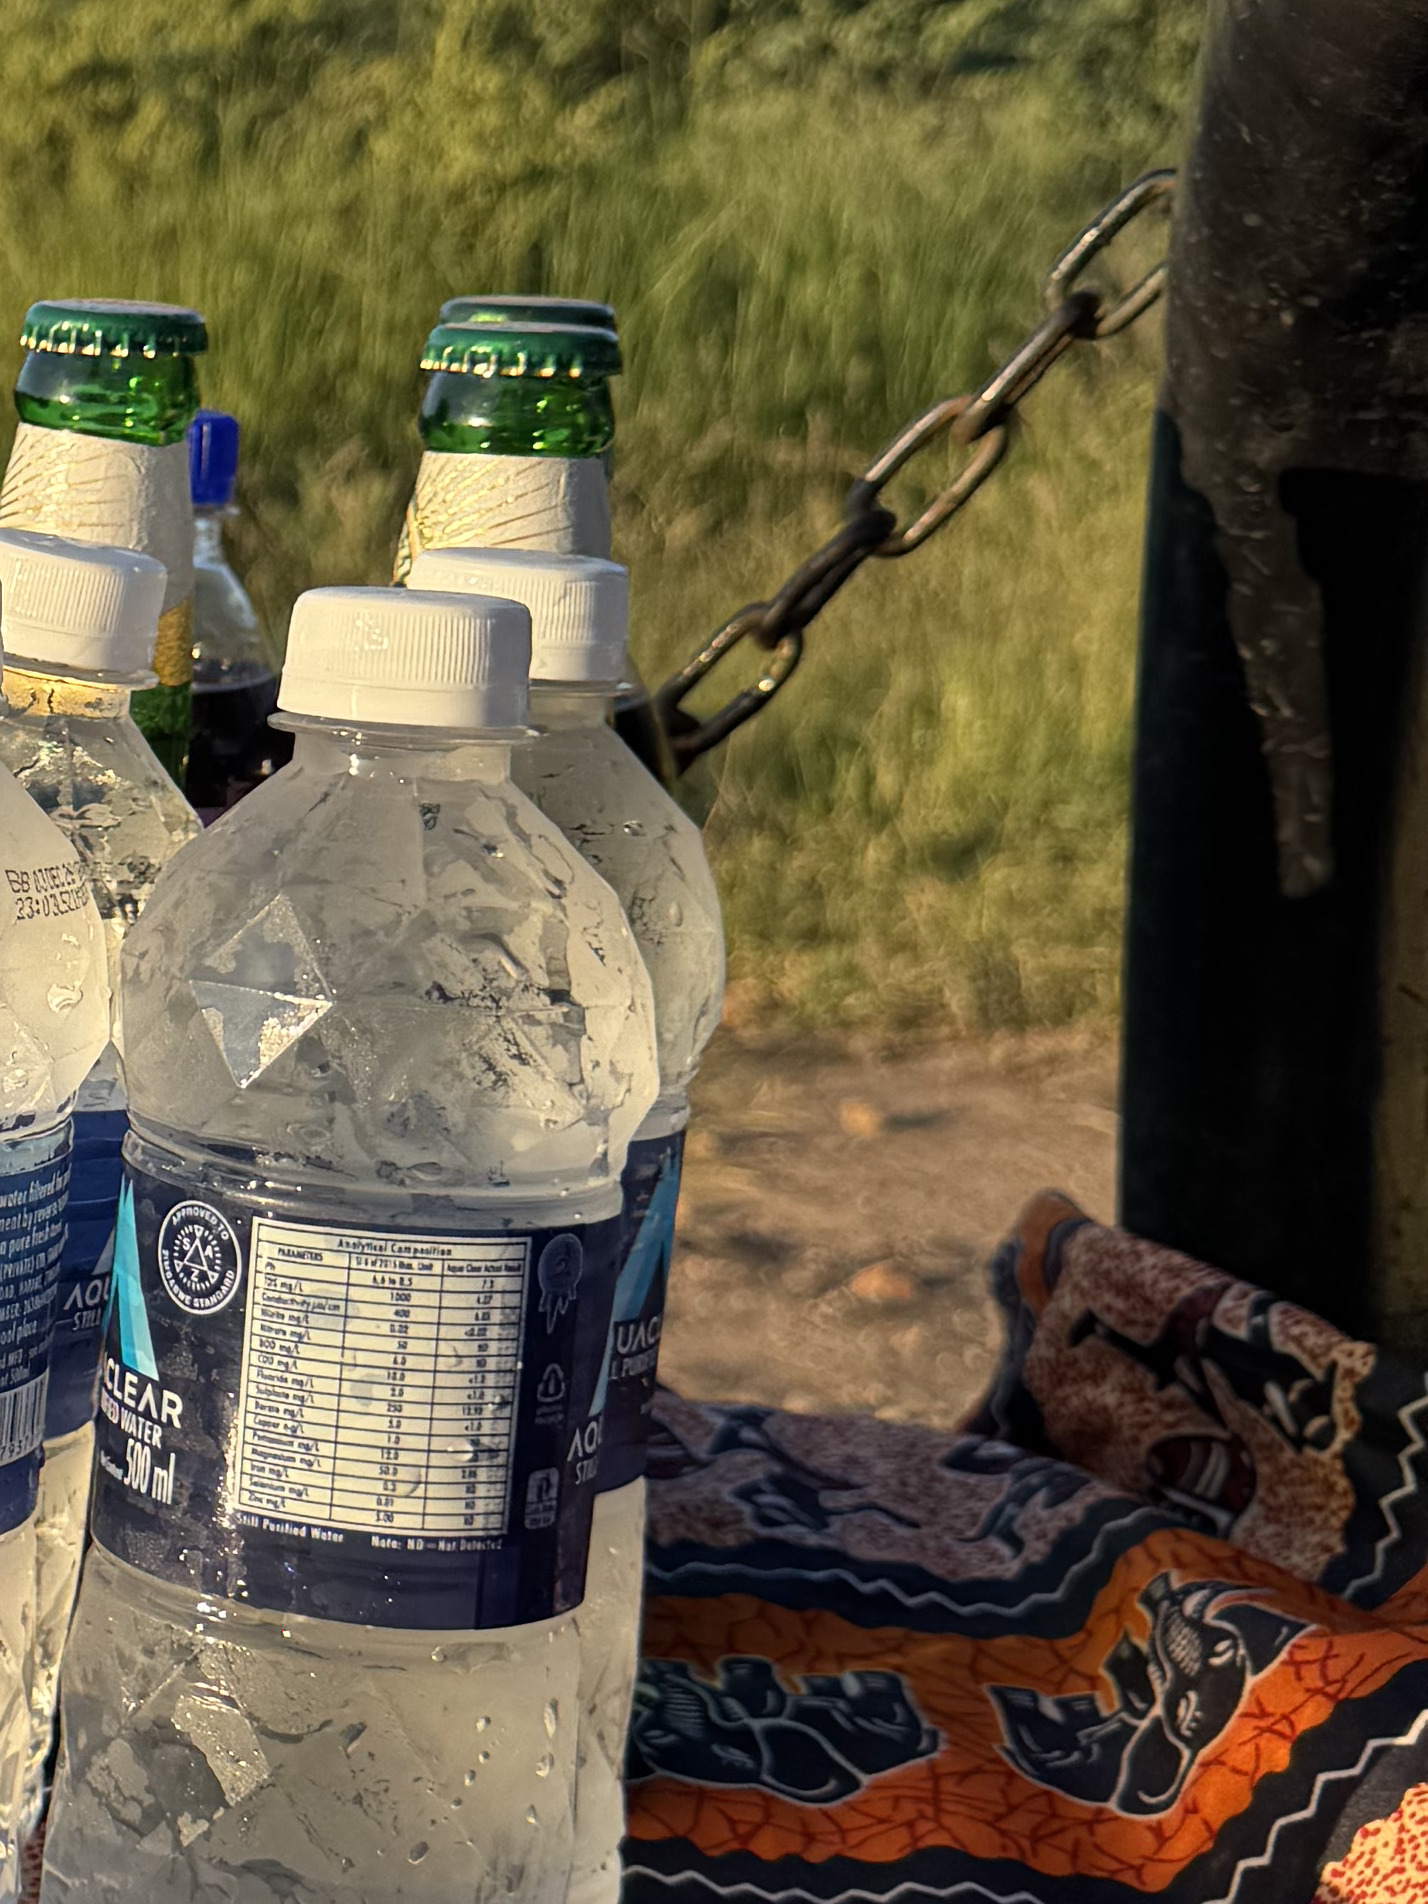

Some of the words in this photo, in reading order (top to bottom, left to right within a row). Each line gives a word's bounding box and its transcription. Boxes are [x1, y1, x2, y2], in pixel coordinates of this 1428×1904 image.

[182, 1237, 191, 1251] S
[120, 1406, 163, 1449] WATER
[123, 1437, 152, 1494] 500
[152, 1452, 177, 1505] ml
